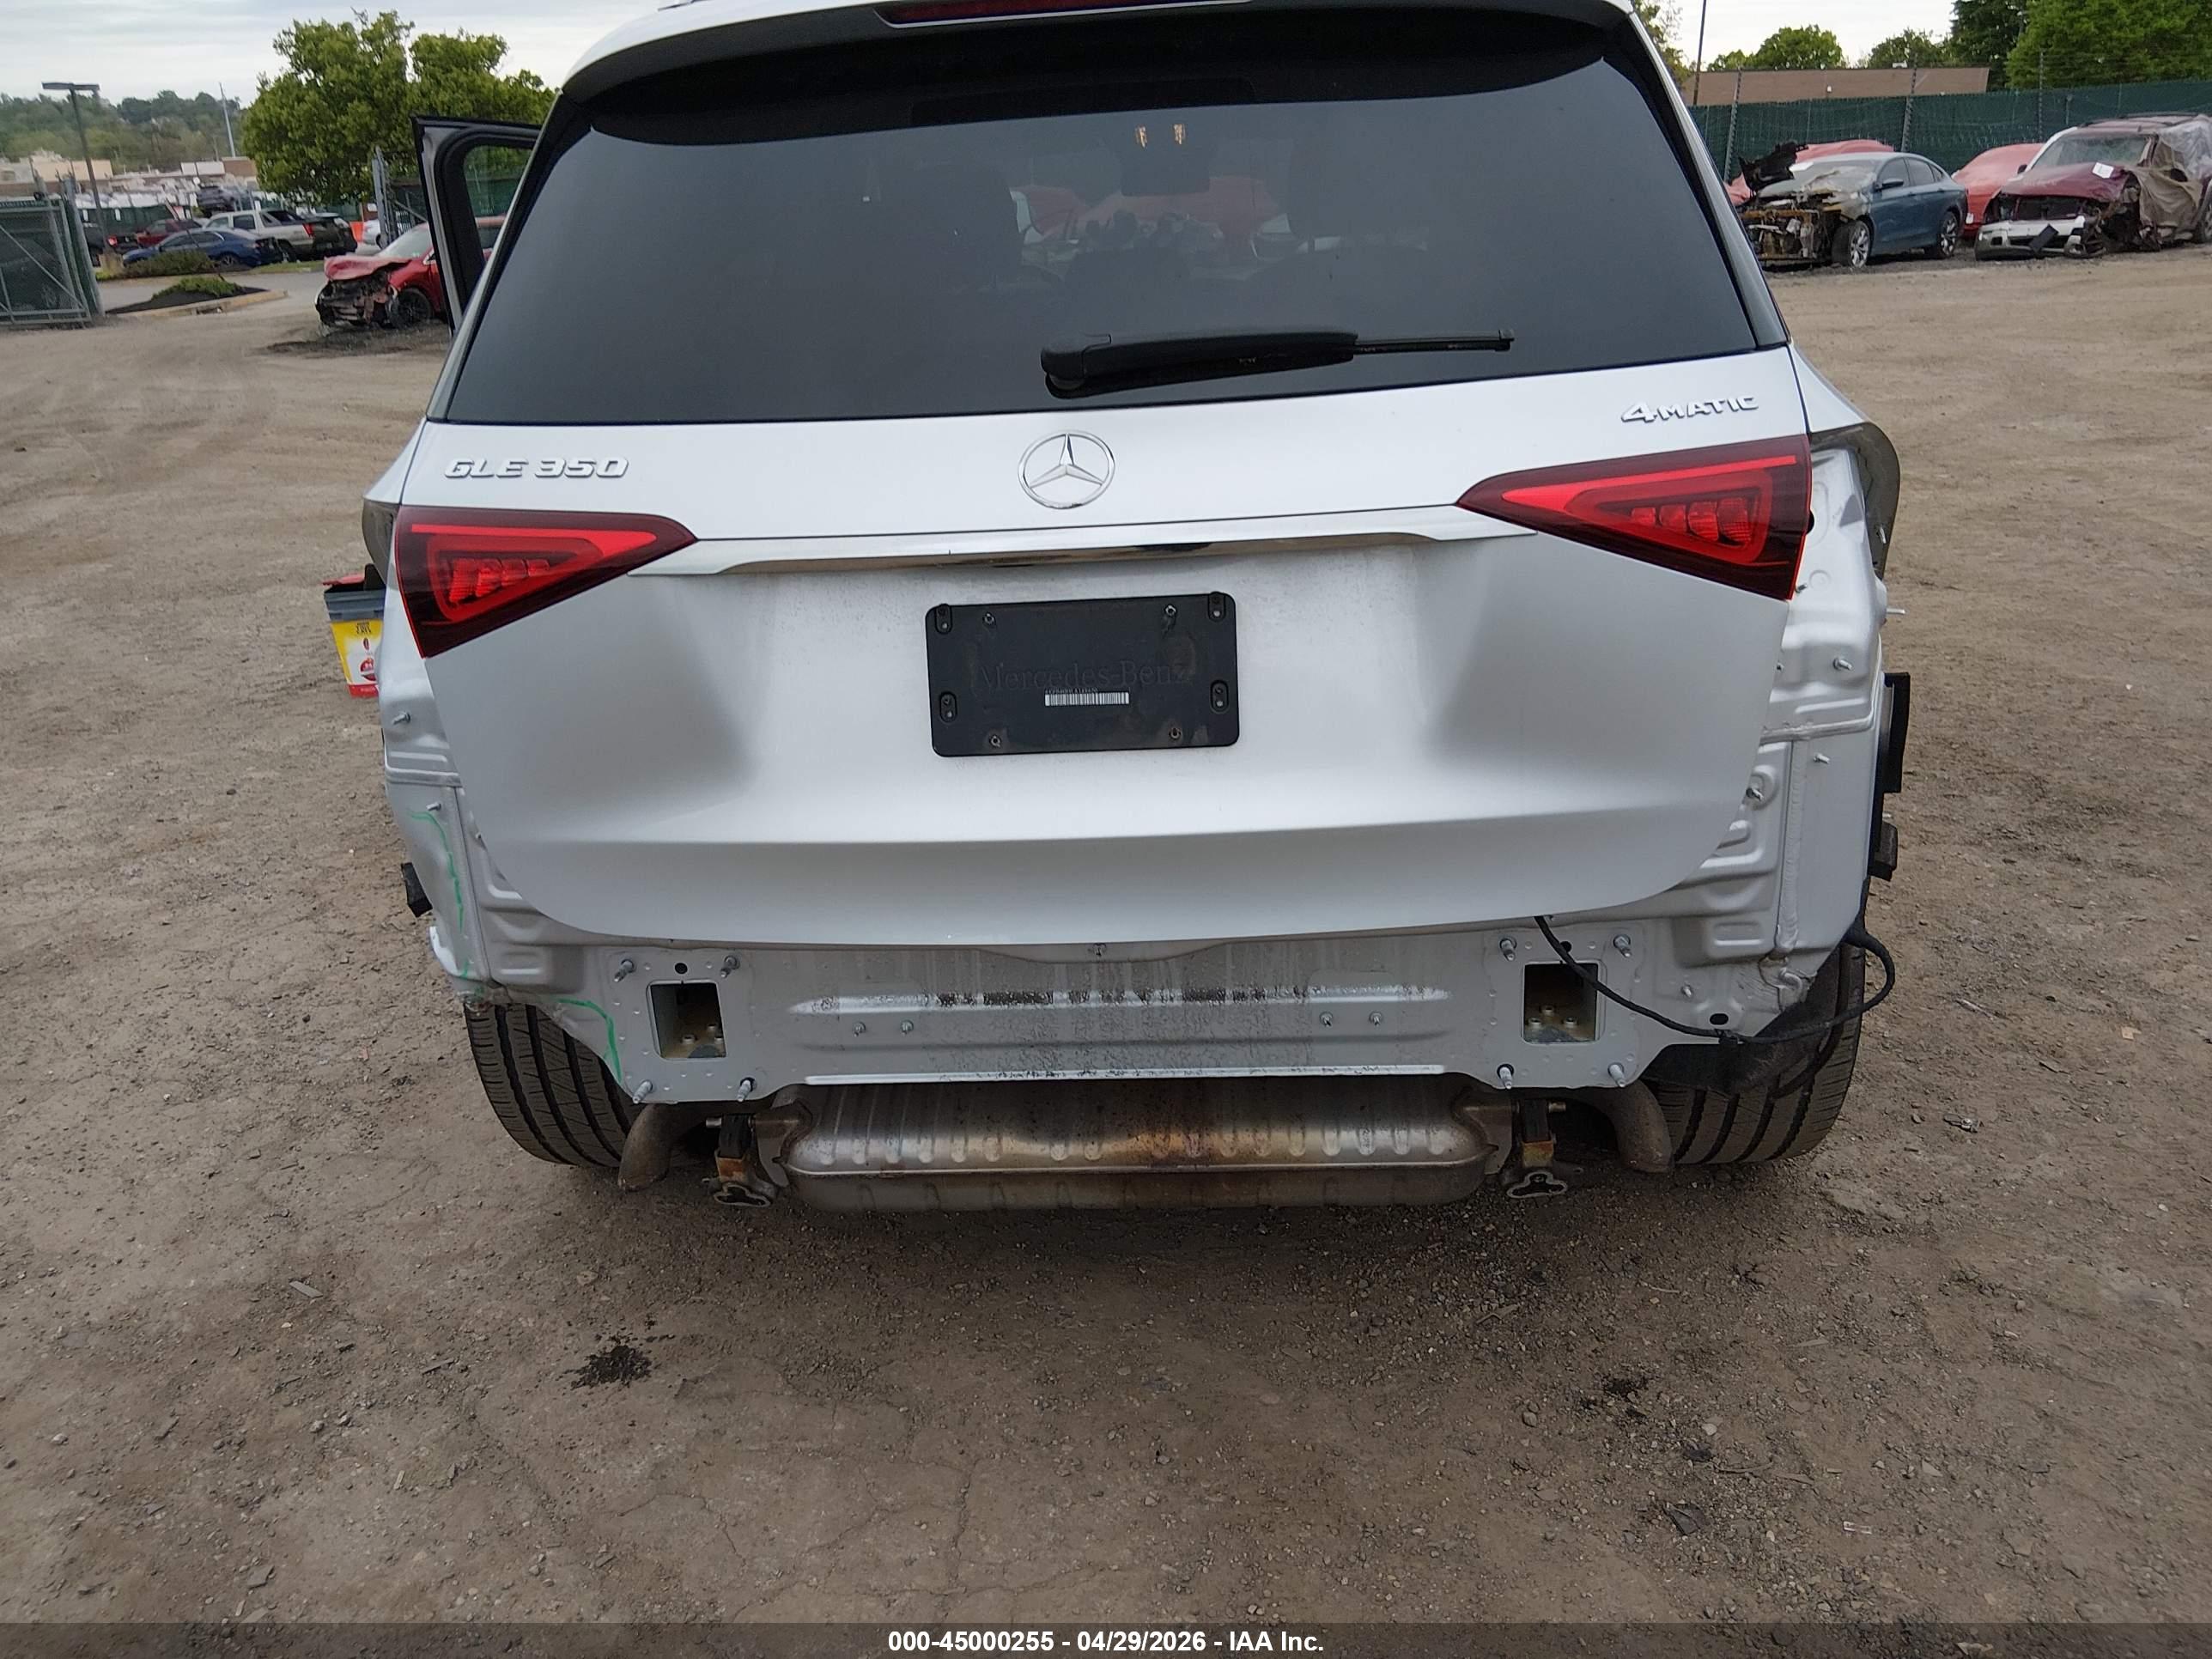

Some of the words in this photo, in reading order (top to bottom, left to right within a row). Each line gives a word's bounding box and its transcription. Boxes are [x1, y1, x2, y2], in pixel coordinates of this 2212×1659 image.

[1620, 395, 1759, 422] 4MATIC
[445, 456, 529, 478] GLE
[534, 456, 629, 478] 350
[977, 659, 1190, 690] Mercedes-Benz
